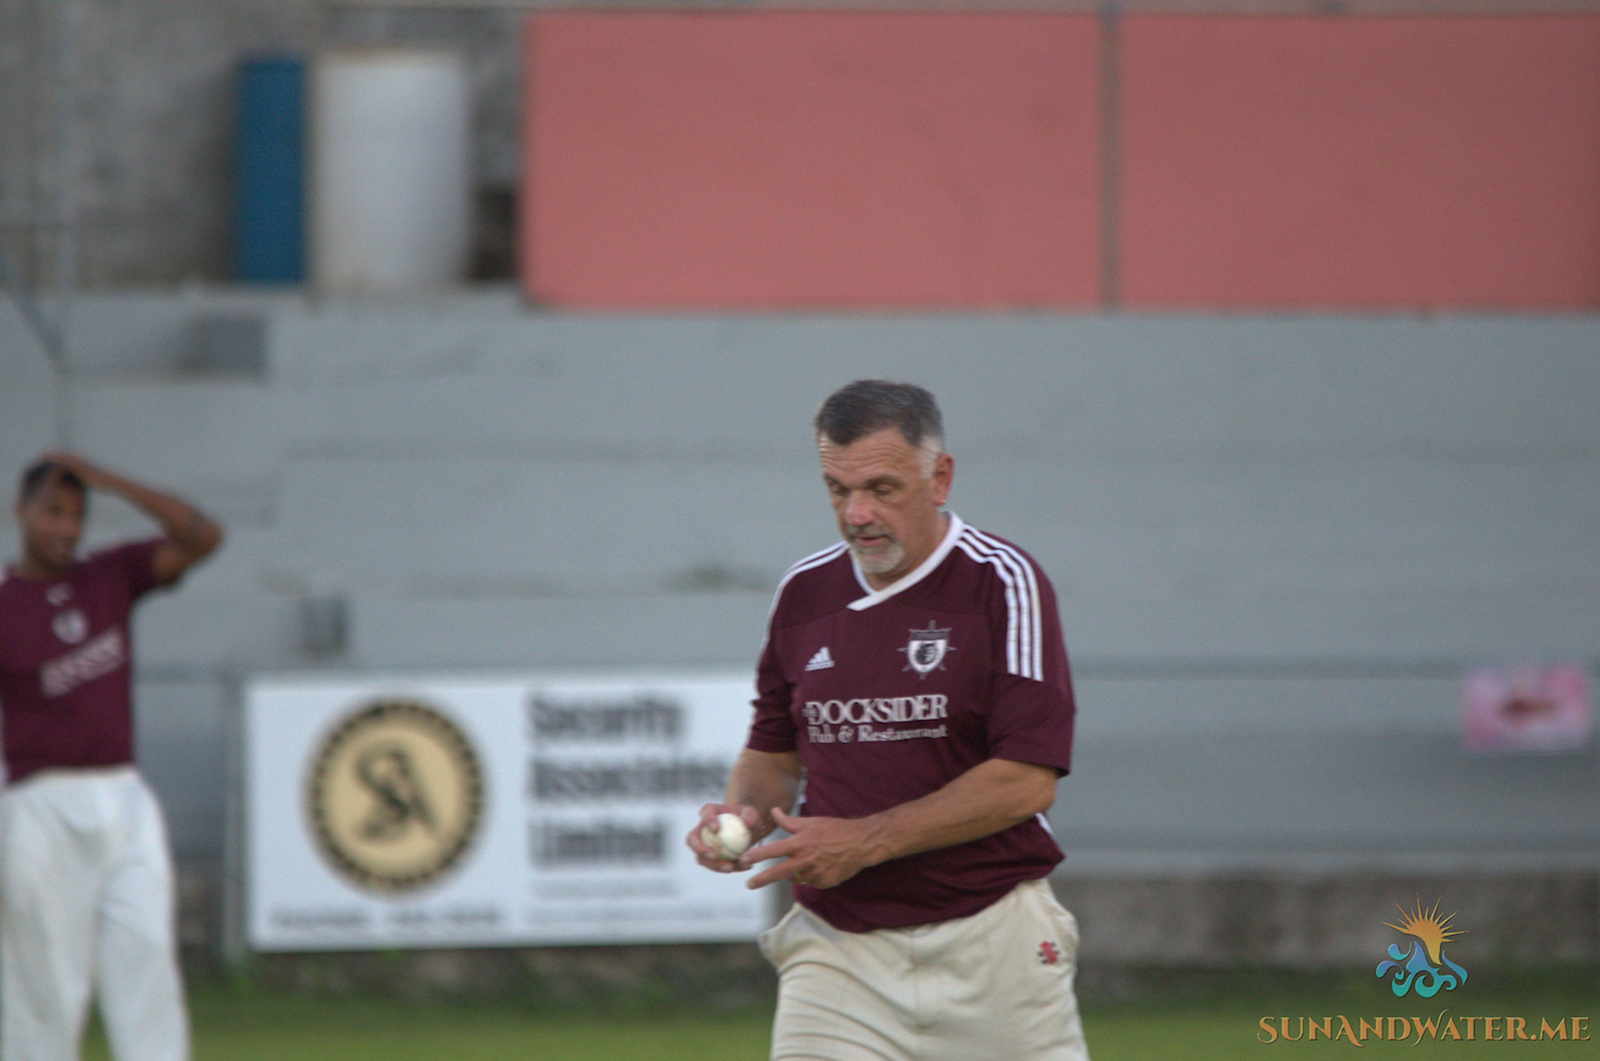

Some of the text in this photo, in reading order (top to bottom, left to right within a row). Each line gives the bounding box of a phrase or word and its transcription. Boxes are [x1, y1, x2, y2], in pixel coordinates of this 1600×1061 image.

[805, 694, 948, 725] DOCKSIDER
[807, 724, 948, 743] Pub & Restaurant
